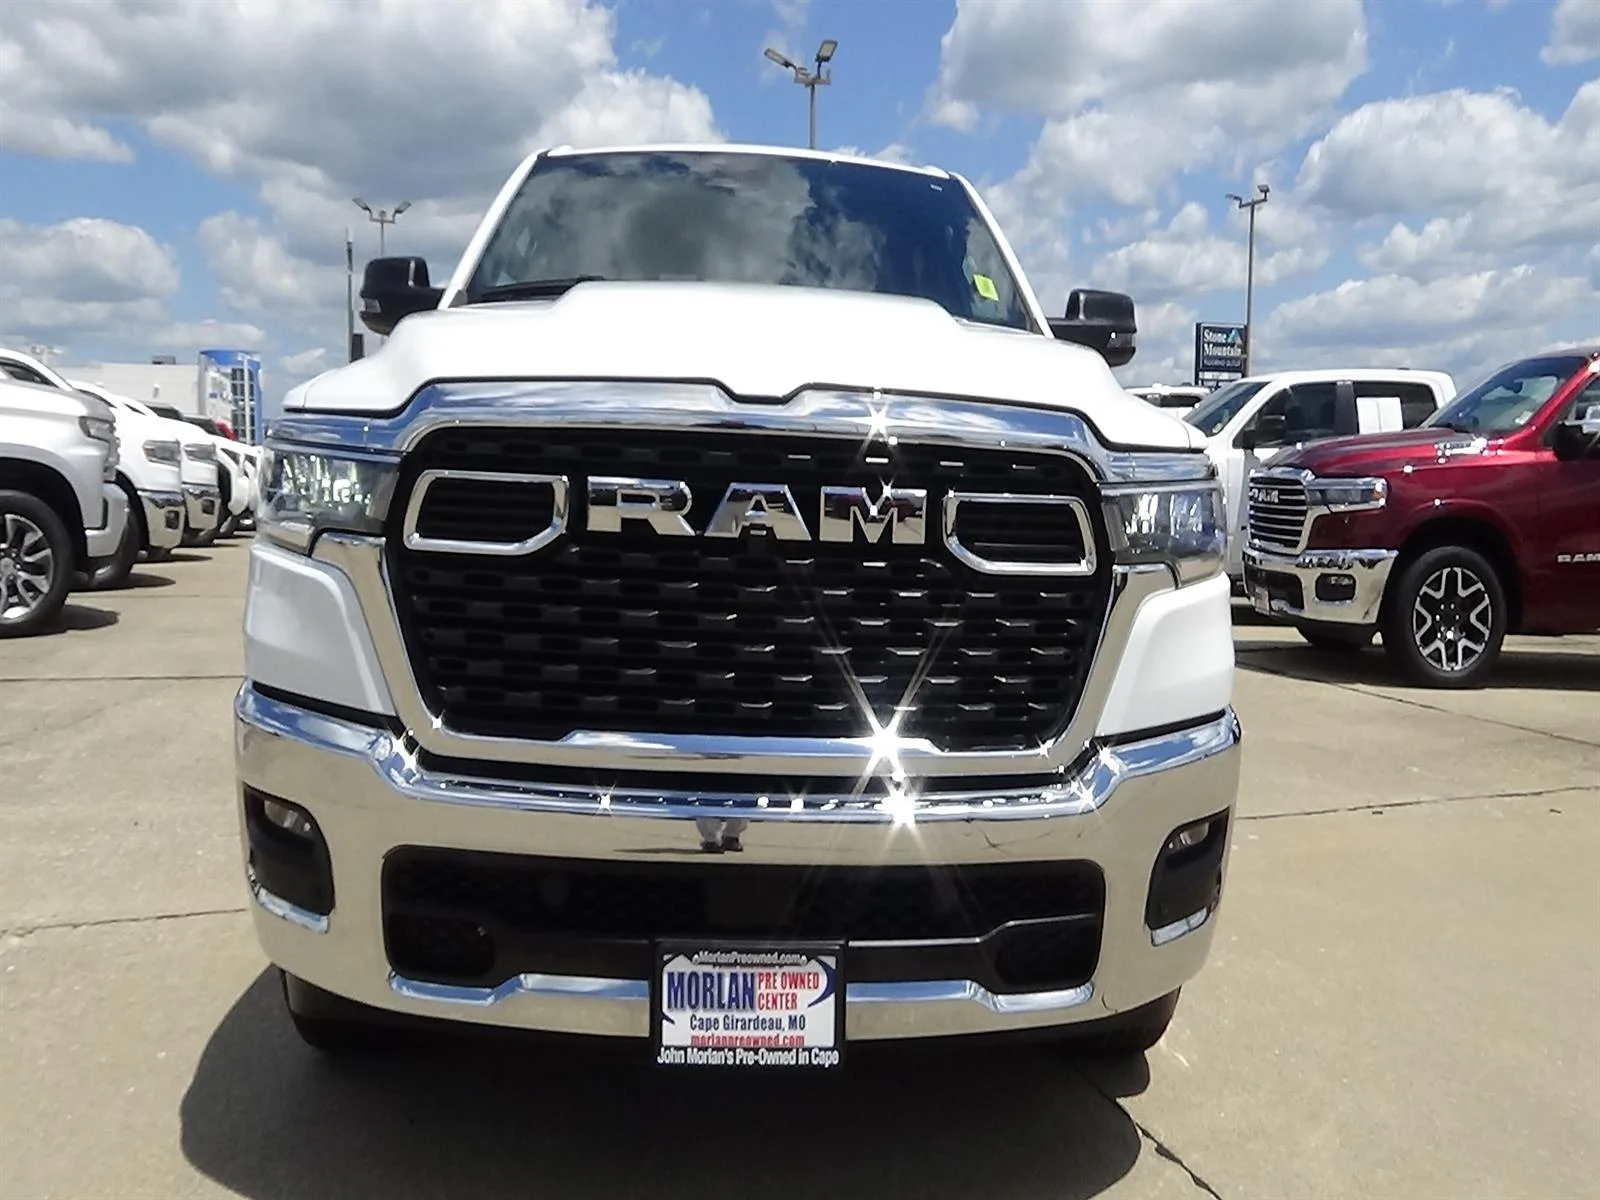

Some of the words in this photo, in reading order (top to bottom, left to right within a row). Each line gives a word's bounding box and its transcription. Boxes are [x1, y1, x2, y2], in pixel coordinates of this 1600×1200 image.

[587, 475, 928, 544] RAM
[1557, 553, 1600, 563] RAM
[757, 972, 778, 990] PRE
[780, 972, 820, 990] OWNED
[667, 971, 756, 1010] MORLAN
[757, 992, 798, 1011] CENTER
[690, 1014, 720, 1032] Cape
[723, 1014, 785, 1032] Girardeau,
[788, 1014, 806, 1031] MO
[691, 1034, 805, 1047] morlanpreowned.com
[657, 1047, 685, 1064] John
[687, 1048, 734, 1065] Morlan's
[735, 1048, 797, 1065] Pre-Owned
[798, 1048, 810, 1065] in
[811, 1048, 840, 1068] Cape
